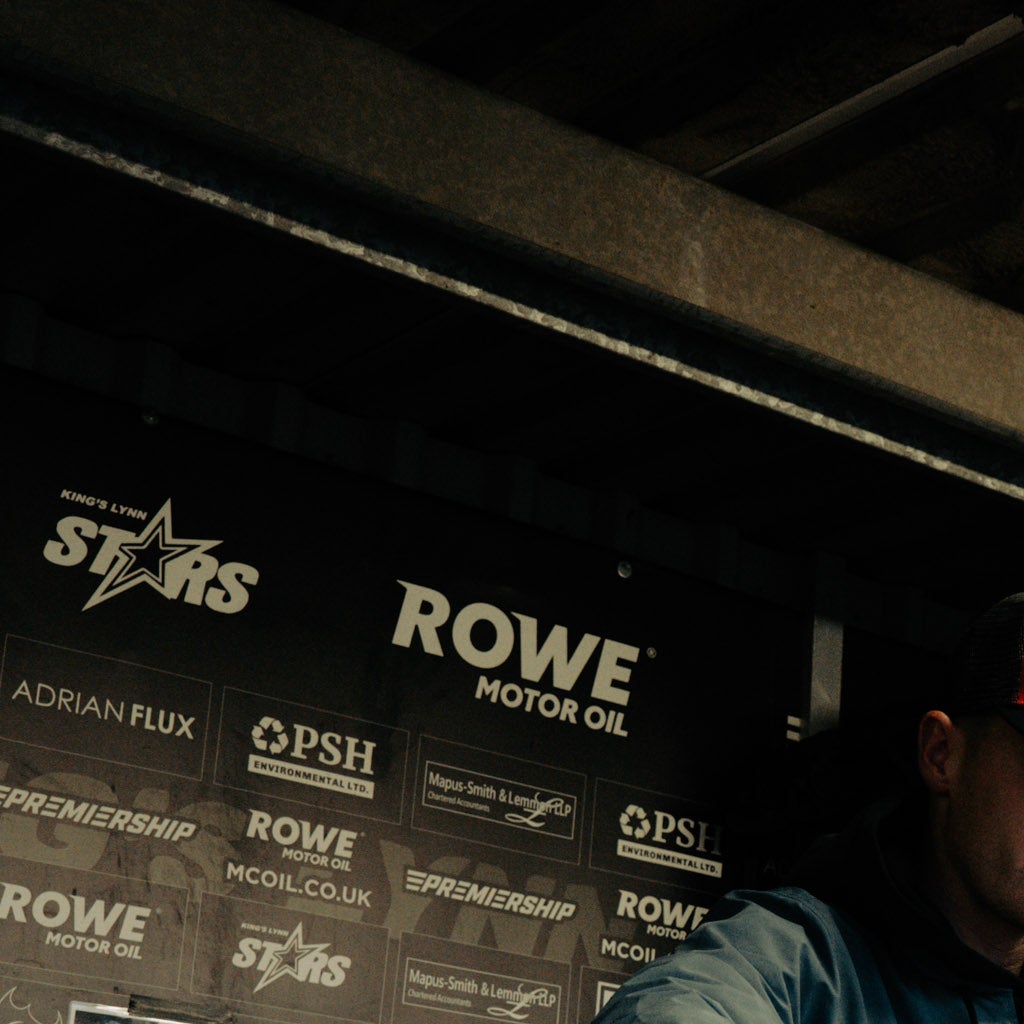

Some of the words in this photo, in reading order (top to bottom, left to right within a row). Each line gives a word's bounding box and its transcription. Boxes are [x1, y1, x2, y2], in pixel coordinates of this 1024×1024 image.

[60, 488, 108, 510] KING'S
[111, 503, 147, 520] LYNN
[391, 579, 640, 706] ROWE
[474, 675, 578, 725] MOTOR
[584, 705, 628, 738] OIL
[291, 724, 377, 775] PSH
[254, 759, 345, 789] ENVIRONMENTAL
[347, 781, 369, 794] LTD.
[428, 771, 496, 802] Mapus-Smith
[498, 788, 507, 802] &
[246, 809, 357, 858] ROWE
[653, 810, 725, 856] PSH
[282, 848, 328, 868] MOTOR
[331, 857, 351, 871] OIL
[622, 844, 697, 869] ENVIRONMENTAL
[227, 862, 372, 907] MCOIL.CO.UK
[406, 869, 576, 921] PREMIERSHIP
[46, 932, 109, 955] MOTOR
[114, 942, 142, 960] OIL
[268, 927, 289, 937] LYNN
[409, 968, 479, 994] Mapus-Smith
[481, 982, 488, 997] &
